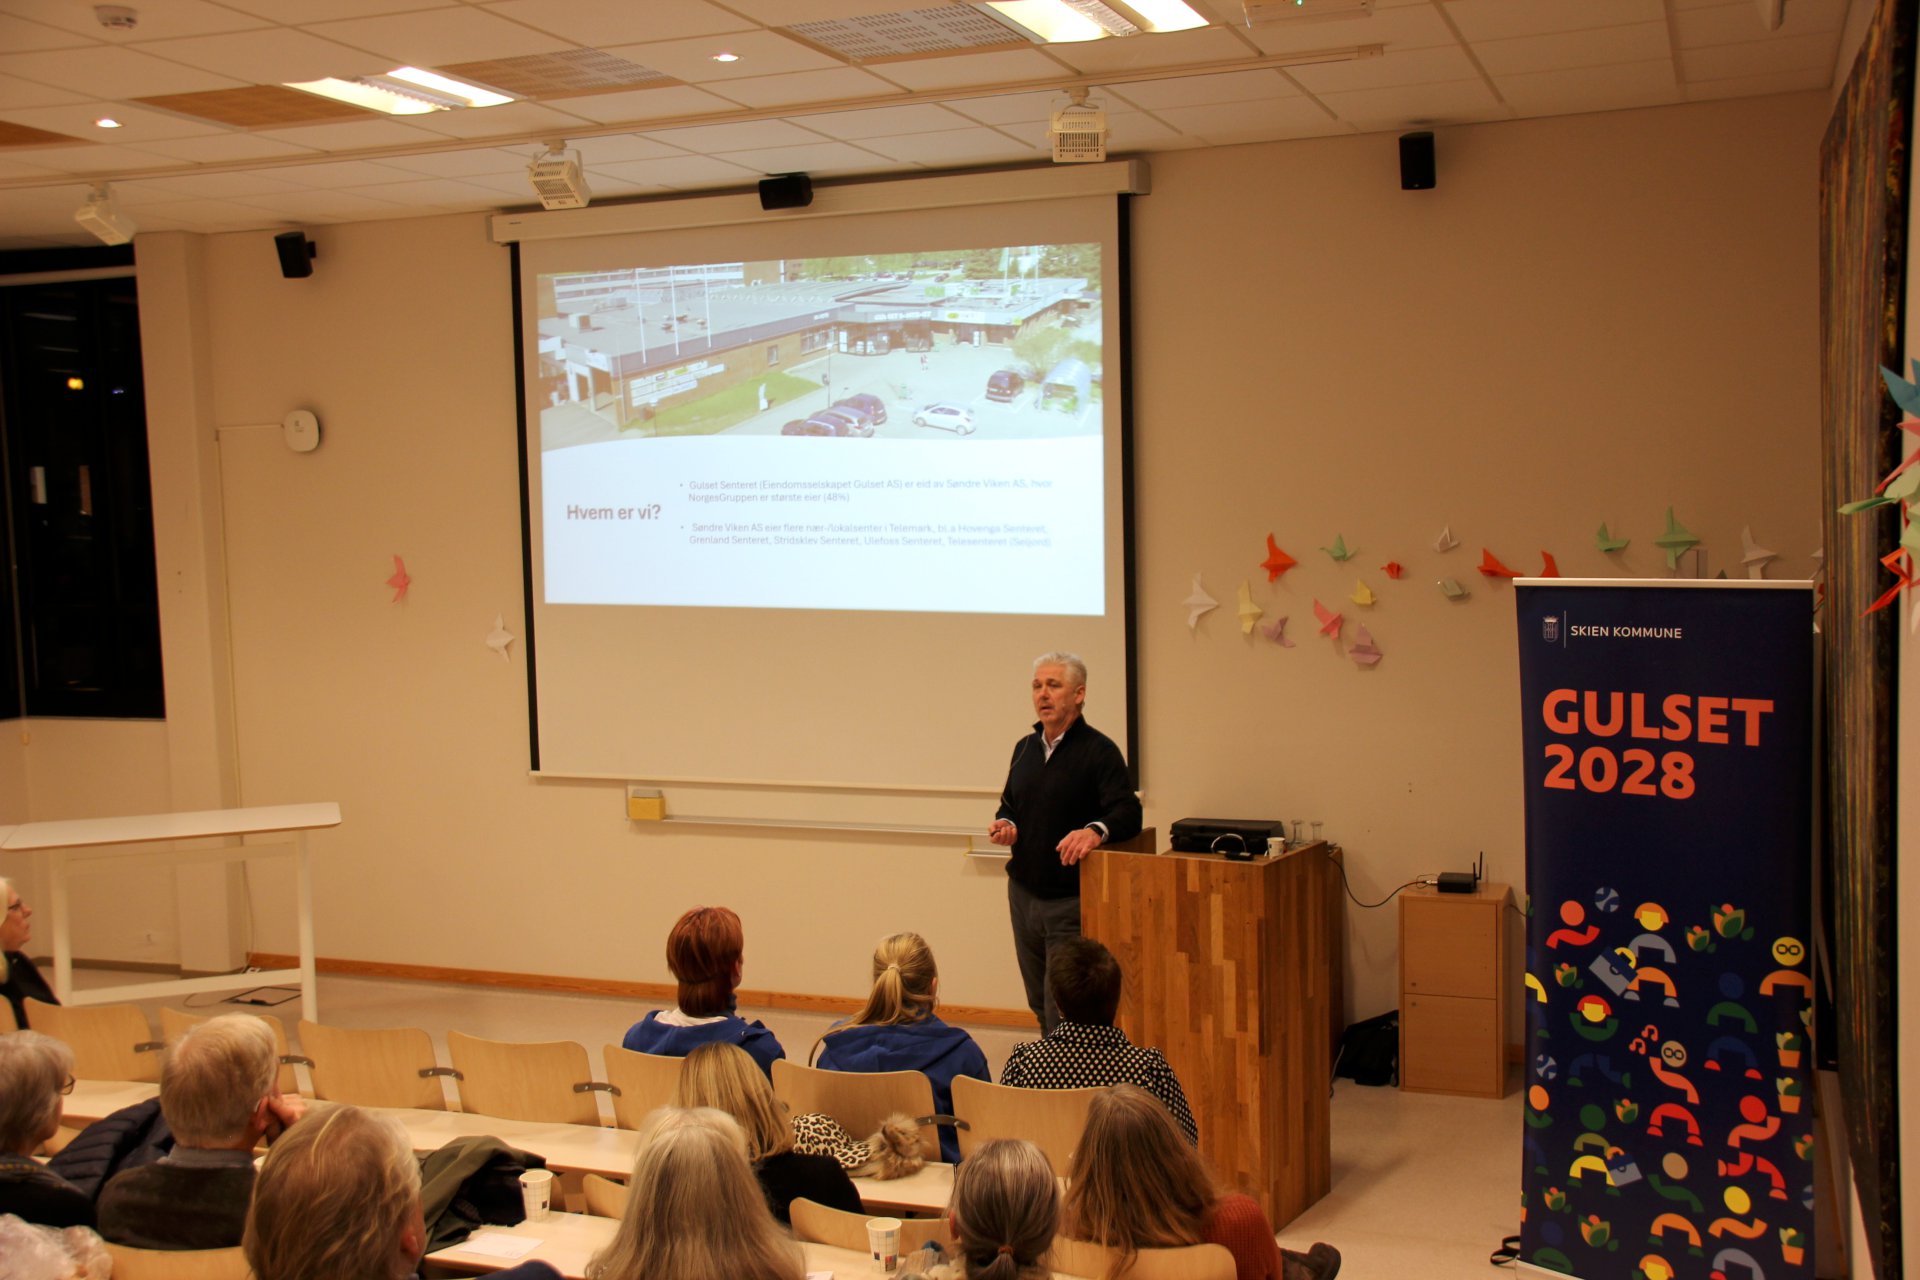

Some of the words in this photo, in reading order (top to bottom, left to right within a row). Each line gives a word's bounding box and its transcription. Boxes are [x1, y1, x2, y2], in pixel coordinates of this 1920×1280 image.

[689, 480, 718, 490] Gulset
[720, 480, 757, 490] Senteret
[759, 479, 852, 491] (Eiendomsselskapet
[853, 479, 885, 489] Gulset
[886, 479, 903, 490] AS)
[916, 479, 931, 489] eid
[946, 479, 981, 489] Søndre
[983, 479, 1010, 489] Viken
[688, 492, 758, 504] NorgesGruppen
[760, 494, 769, 502] er
[770, 493, 802, 502] største
[804, 493, 821, 502] eier
[823, 492, 850, 503] (48%)
[566, 504, 614, 520] Hvem
[617, 507, 635, 520] er
[637, 504, 662, 520] vi?
[692, 522, 724, 532] Søndre
[724, 522, 749, 532] Viken
[751, 522, 764, 532] AS
[765, 523, 782, 532] eier
[783, 522, 804, 532] flere
[689, 535, 730, 545] Grenland
[731, 535, 772, 546] Senteret,
[774, 535, 818, 545] Stridsklev
[820, 536, 862, 547] Senteret,
[864, 536, 900, 546] Ulefoss
[902, 536, 945, 547] Senteret,
[1570, 625, 1610, 637] SKIEN
[1613, 626, 1682, 639] KOMMUNE
[1542, 688, 1774, 747] GULSET
[1543, 743, 1696, 800] 2028
